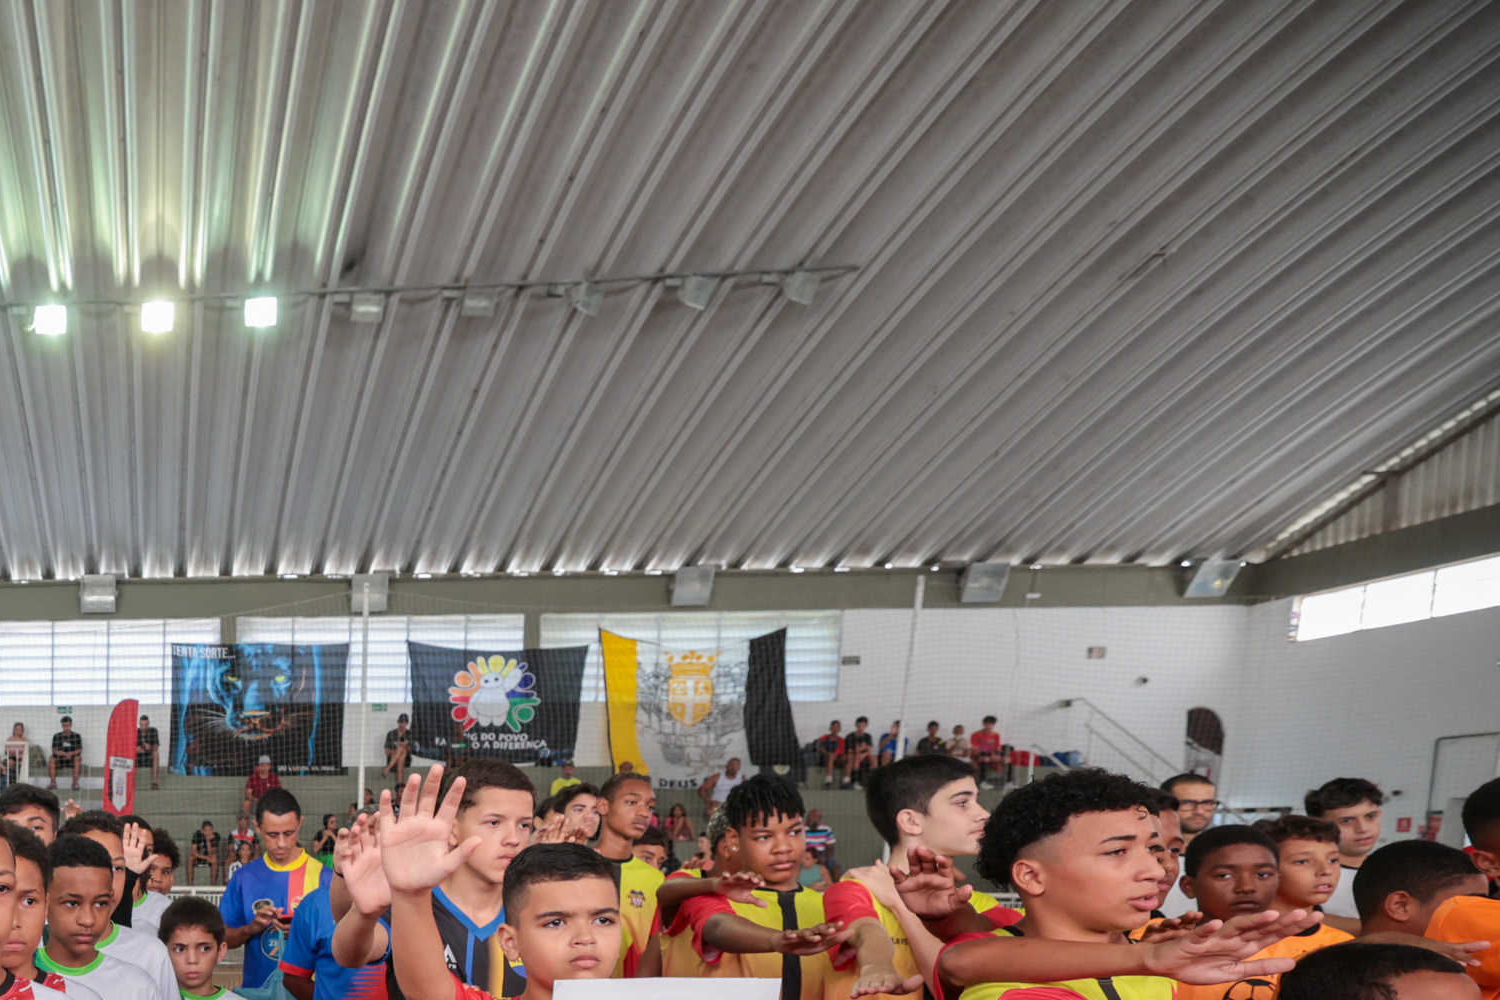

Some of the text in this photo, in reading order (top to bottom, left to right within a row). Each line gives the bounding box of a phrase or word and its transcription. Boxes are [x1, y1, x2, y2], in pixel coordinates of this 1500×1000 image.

[172, 645, 198, 657] TENTA
[481, 733, 496, 741] DO
[498, 733, 528, 742] POVO
[493, 739, 547, 750] DIFERENÇA
[660, 778, 698, 788] DEUS
